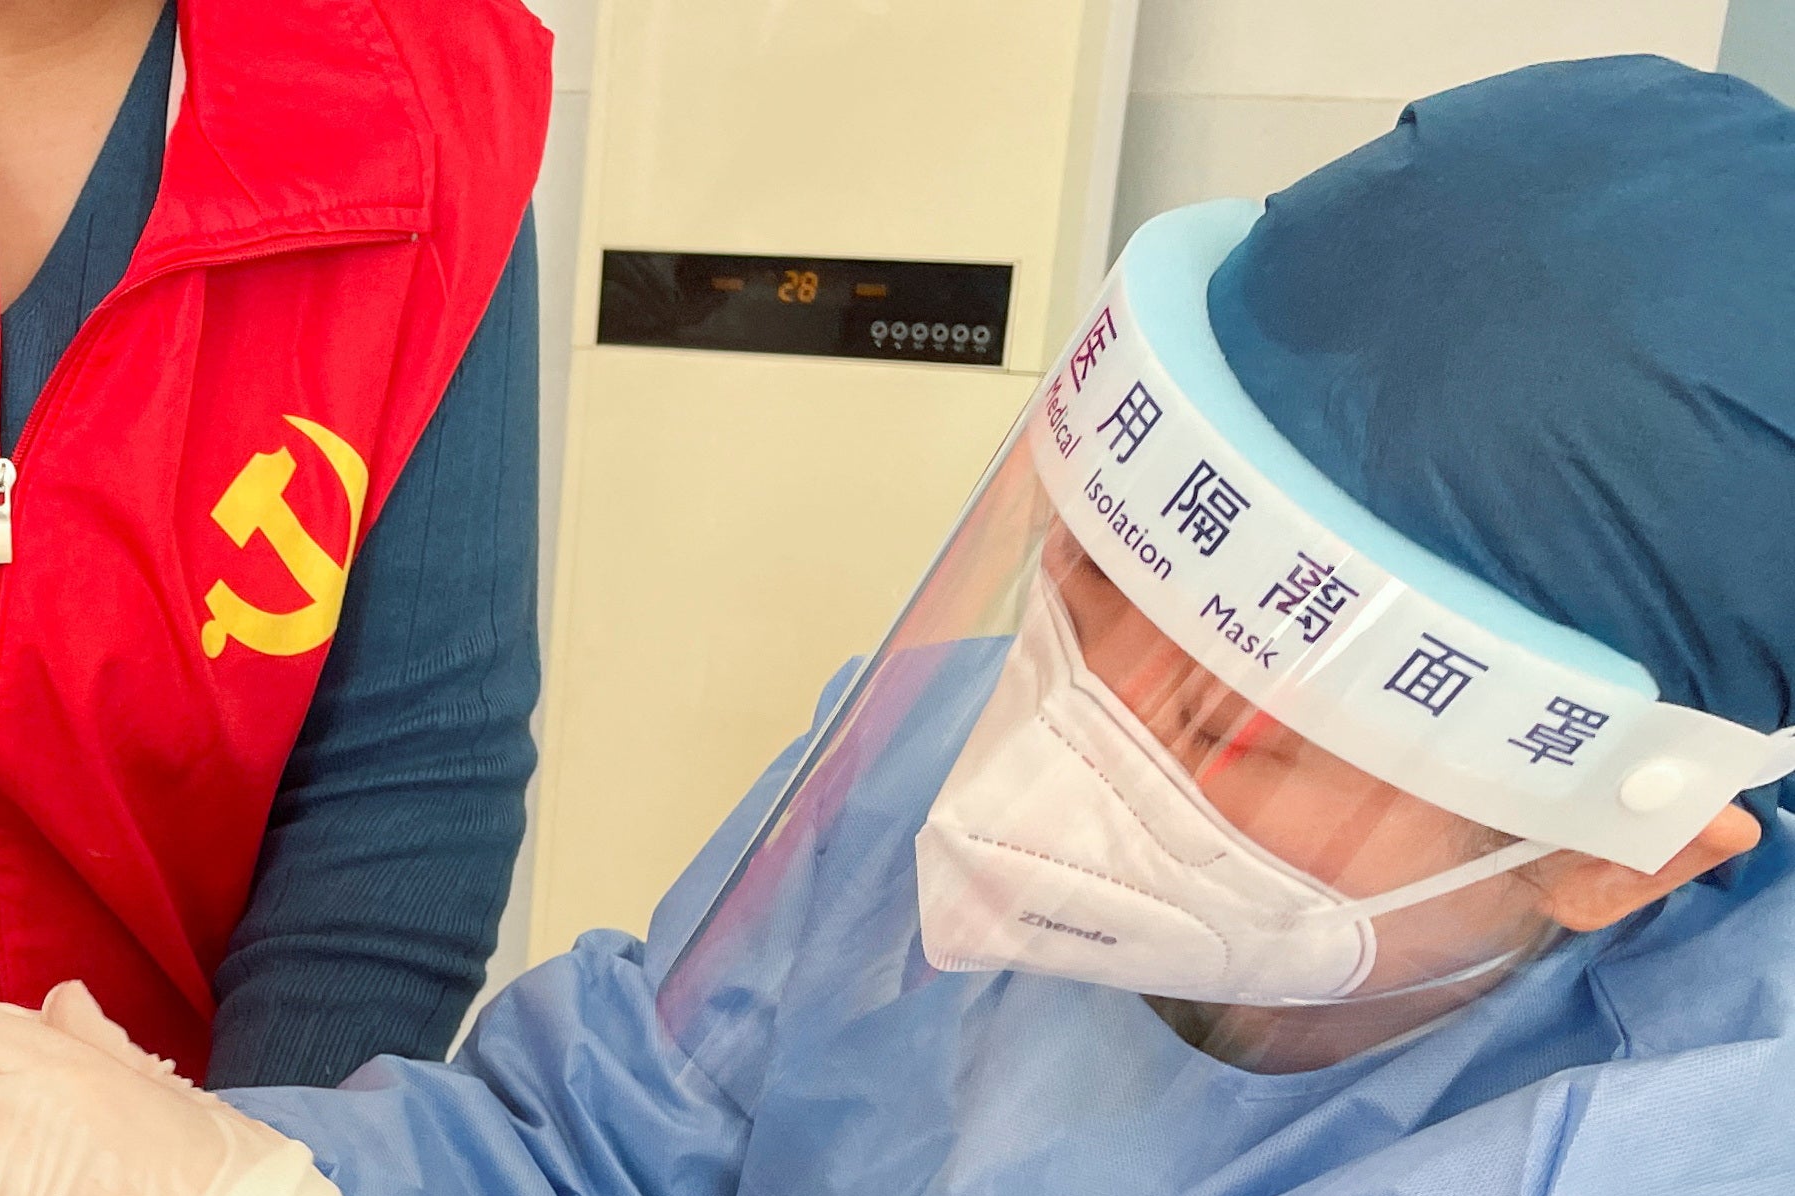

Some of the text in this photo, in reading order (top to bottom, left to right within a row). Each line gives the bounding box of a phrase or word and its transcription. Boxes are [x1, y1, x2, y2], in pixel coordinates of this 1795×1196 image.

[778, 270, 818, 304] 28
[1044, 374, 1280, 669] Medical Isolation Mask
